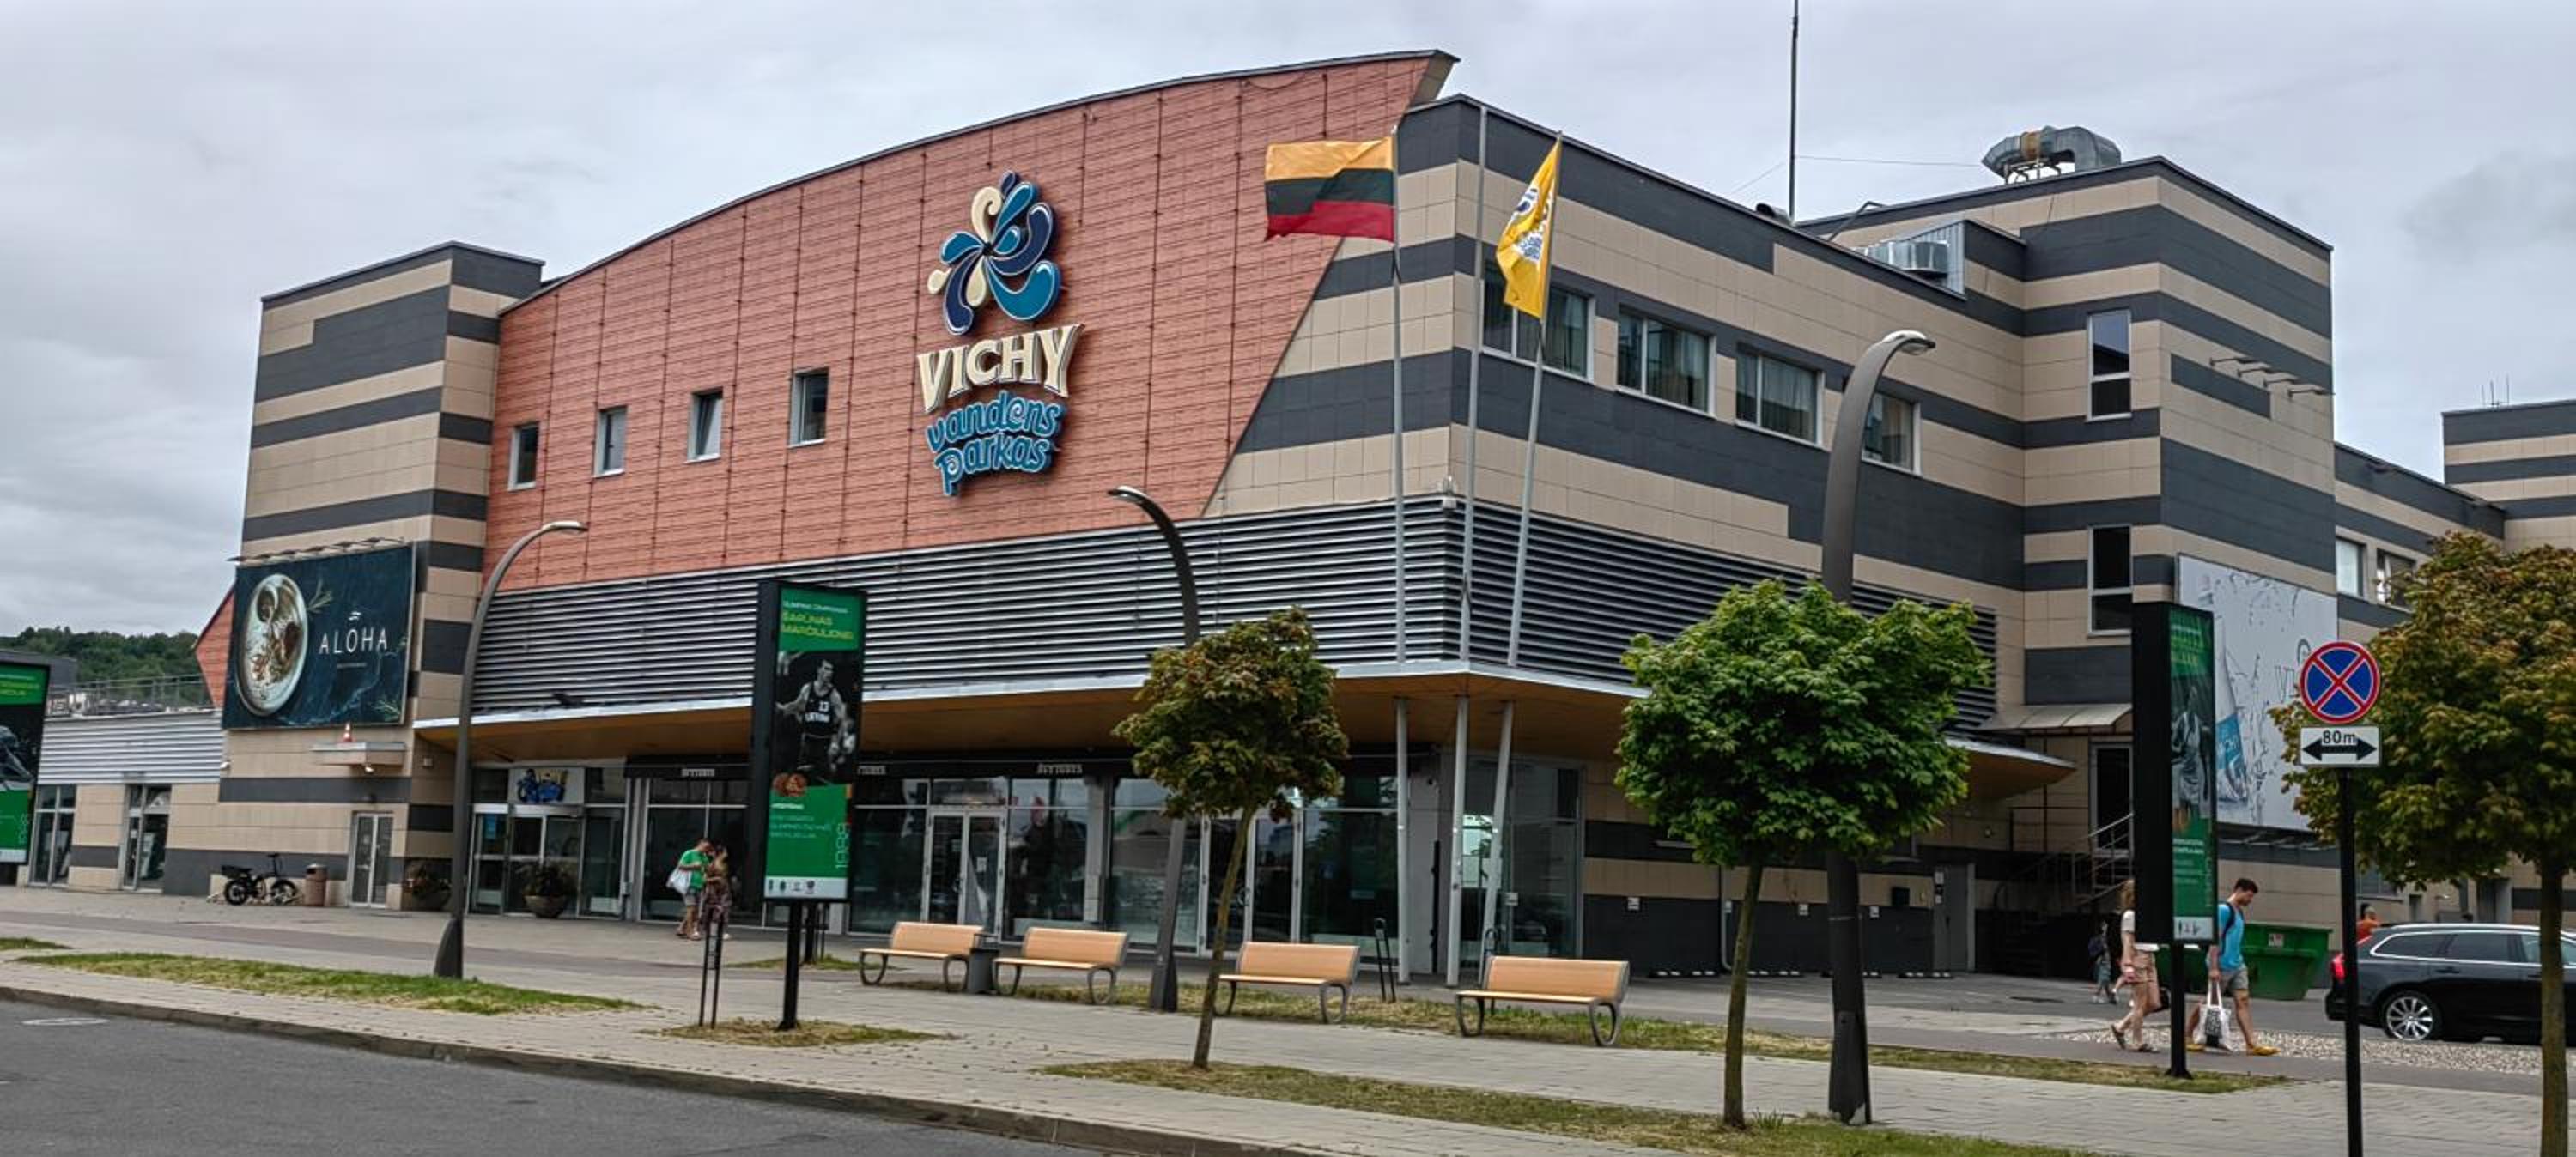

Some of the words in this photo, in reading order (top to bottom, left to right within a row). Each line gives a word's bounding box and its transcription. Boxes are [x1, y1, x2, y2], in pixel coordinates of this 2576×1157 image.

[918, 324, 1084, 413] VICHY
[927, 391, 1063, 452] vandens
[934, 433, 1051, 495] parkas
[319, 627, 388, 655] ALOHA
